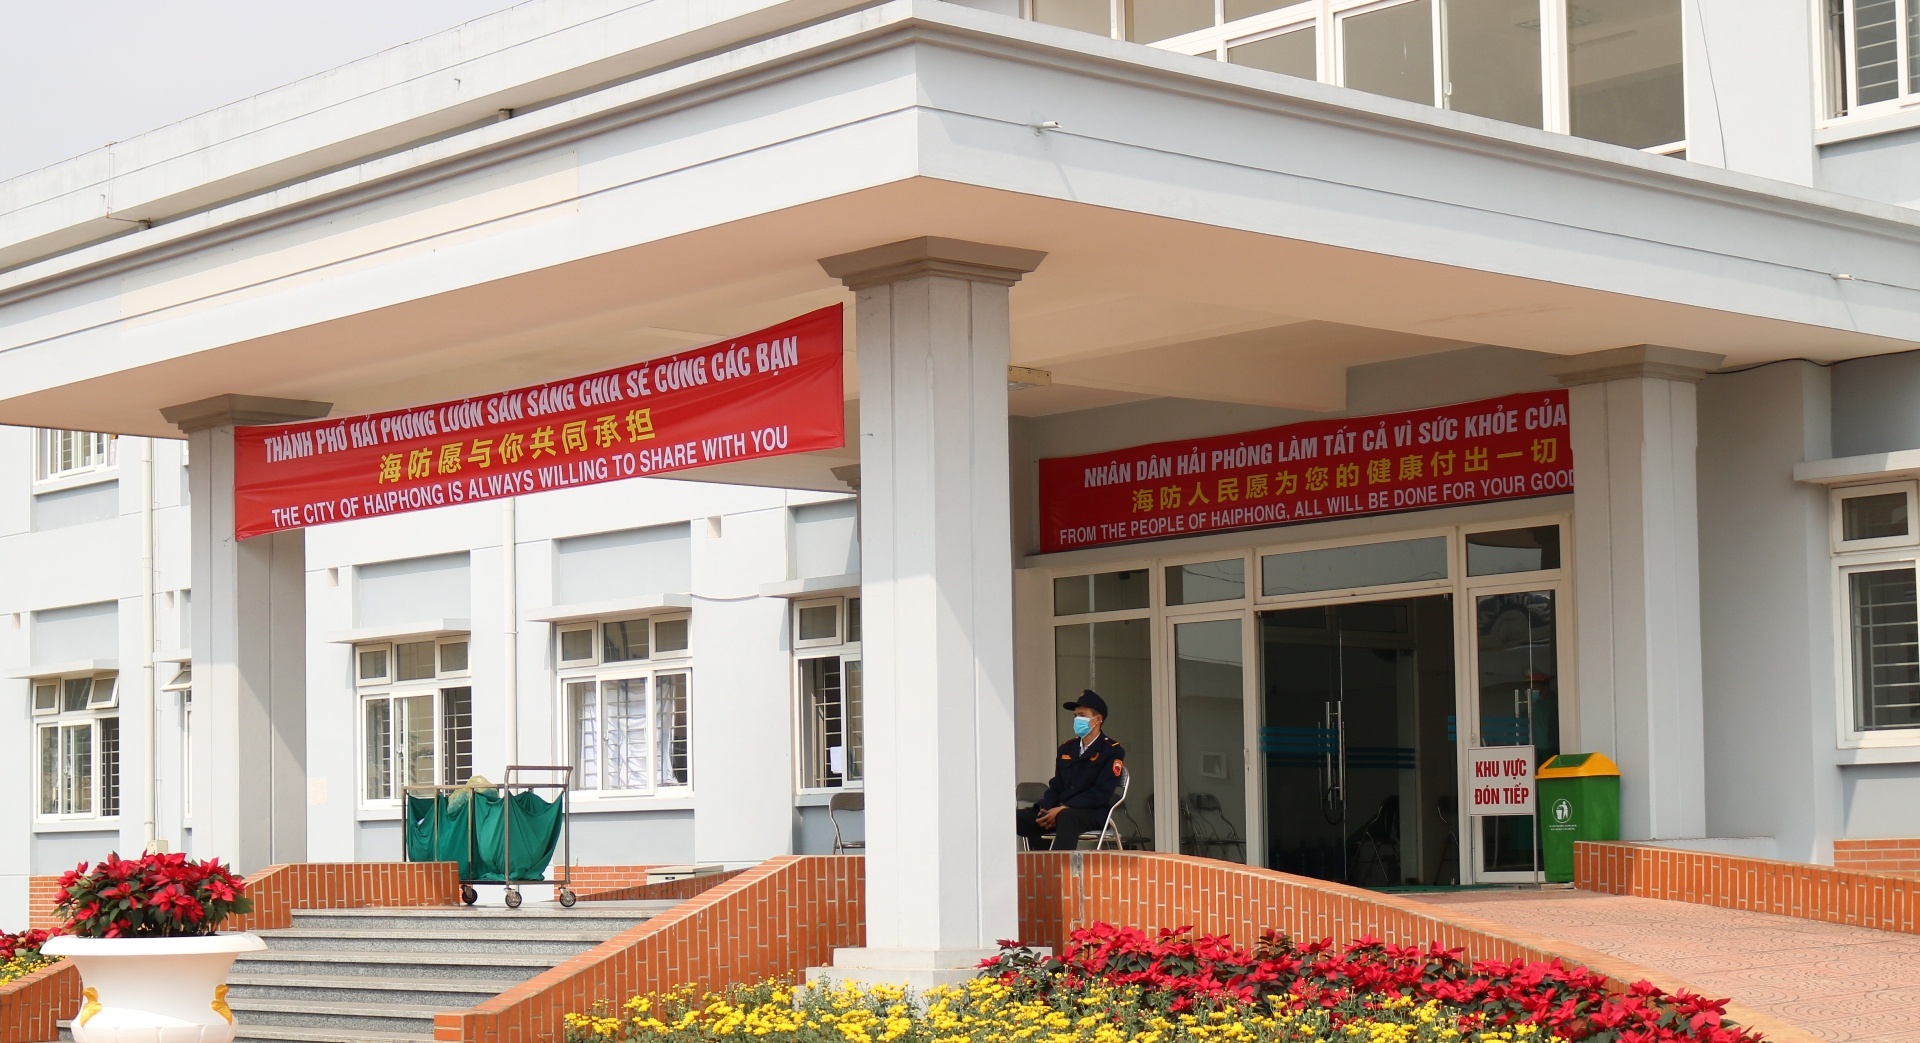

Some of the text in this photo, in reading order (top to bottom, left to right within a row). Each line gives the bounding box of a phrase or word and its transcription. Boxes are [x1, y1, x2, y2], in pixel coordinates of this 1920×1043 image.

[264, 431, 313, 463] THÀNH
[315, 418, 348, 454] PHỐ
[350, 413, 378, 448] HẢI
[381, 407, 437, 443] PHÒNG
[439, 398, 484, 433] LUÔN
[527, 383, 576, 416] SÀNG
[579, 374, 624, 407] CHIA
[626, 360, 652, 398] SẺ
[654, 356, 708, 393] CÙNG
[711, 344, 750, 381] CÁC
[756, 336, 798, 376] BẠN
[271, 426, 788, 528] THE CITY OF HAIPHONG IS ALWAYS WILLING TO SHARE WITH YOU
[378, 407, 656, 485] 海防愿与你共同承担
[1084, 399, 1567, 488] NHÂN DÂN HẢI PHÒNG LÀM TẤT CẢ VÌ SỨC KHỎE CỦA
[1131, 438, 1557, 513] 海防人民愿为您的健康付出一切
[1060, 526, 1097, 544] FROM
[1100, 522, 1127, 539] THE
[1130, 514, 1184, 536] PEOPLE
[1188, 512, 1206, 530] OF
[1211, 503, 1290, 526] HAIPHONG,
[1294, 500, 1323, 517] ALL
[1327, 495, 1363, 513] WILL
[1368, 490, 1388, 508] BE
[1394, 485, 1438, 506] DONE
[1443, 481, 1475, 499] FOR
[1481, 475, 1525, 495] YOUR
[1474, 782, 1530, 805] ĐÓN TIẾP
[1475, 758, 1527, 780] KHU VỰC
